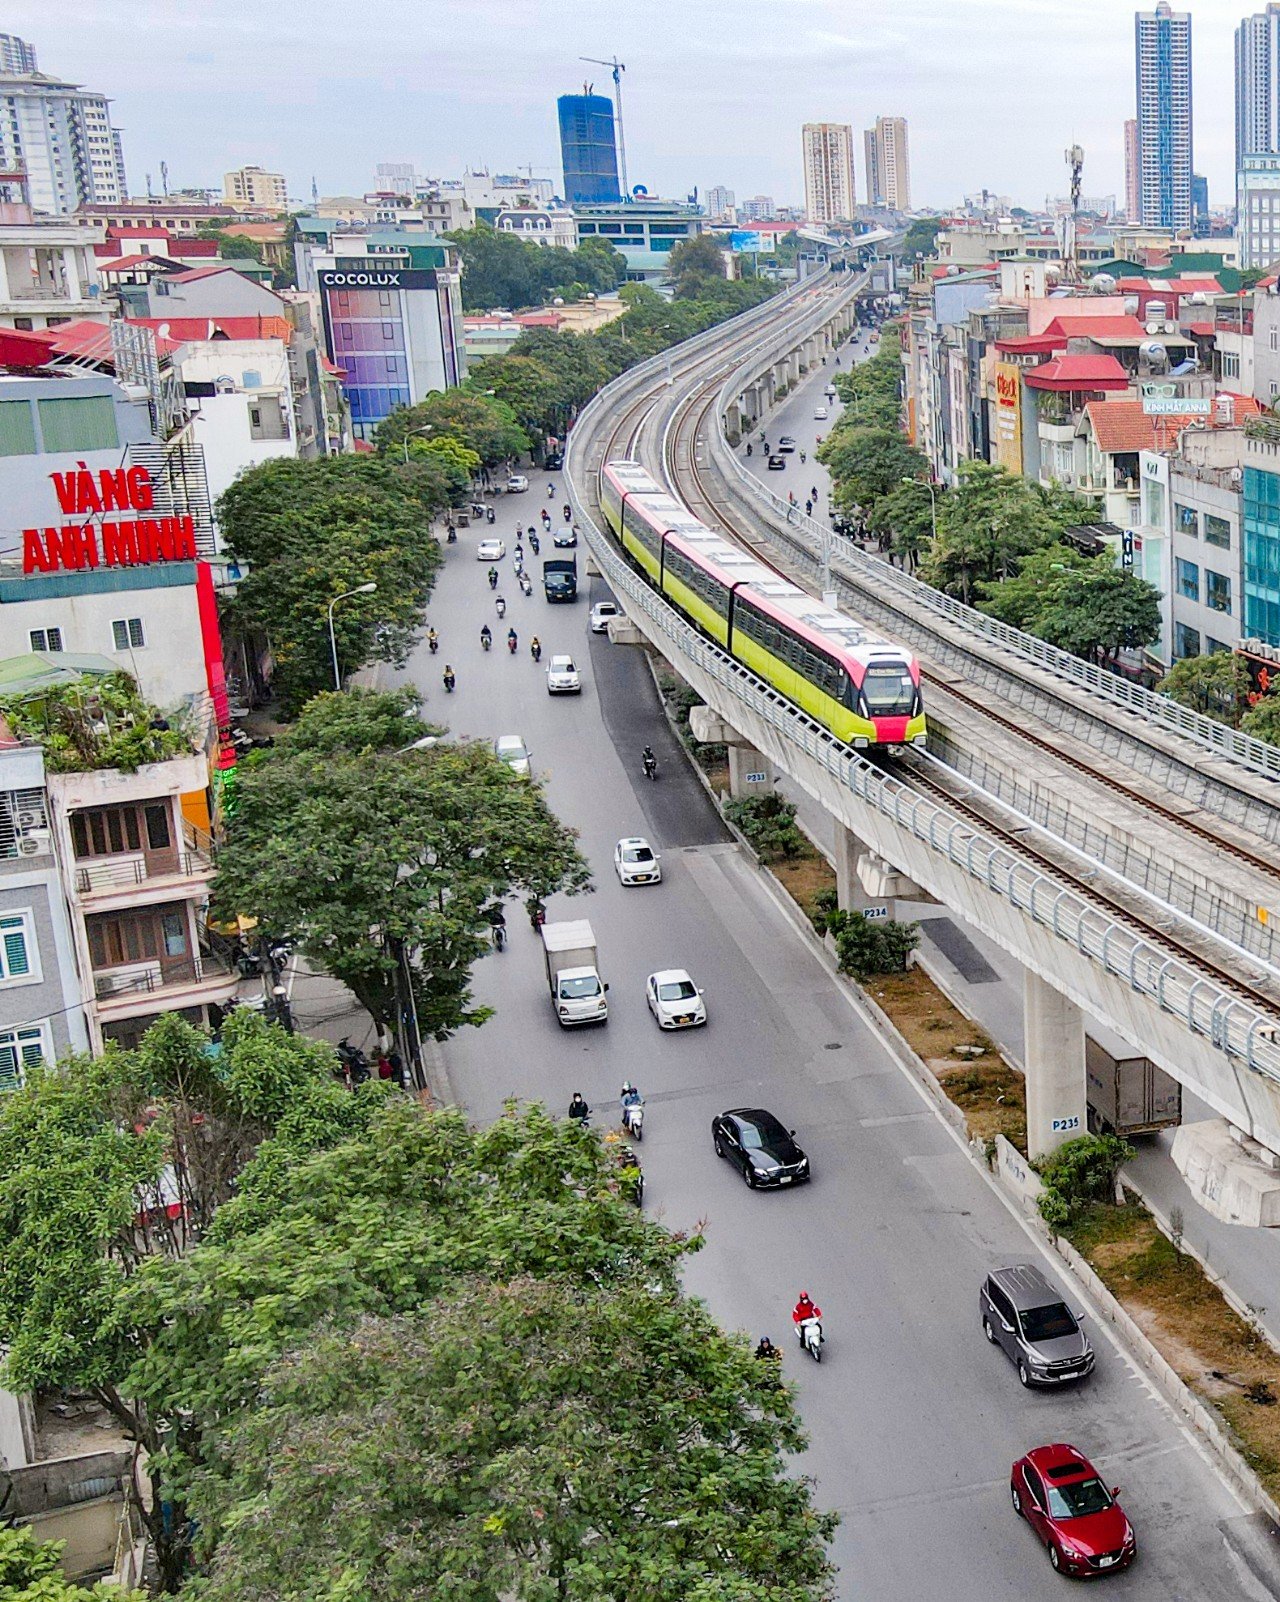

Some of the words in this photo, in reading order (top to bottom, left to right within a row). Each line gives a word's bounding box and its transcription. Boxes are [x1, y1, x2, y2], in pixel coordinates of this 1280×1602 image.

[323, 273, 400, 285] COCOLUX
[1185, 402, 1208, 412] ANNA
[51, 461, 153, 514] VÀNG
[22, 524, 100, 575] ANH
[101, 515, 197, 566] MINH
[864, 907, 887, 918] P234
[1053, 1116, 1079, 1131] P235
